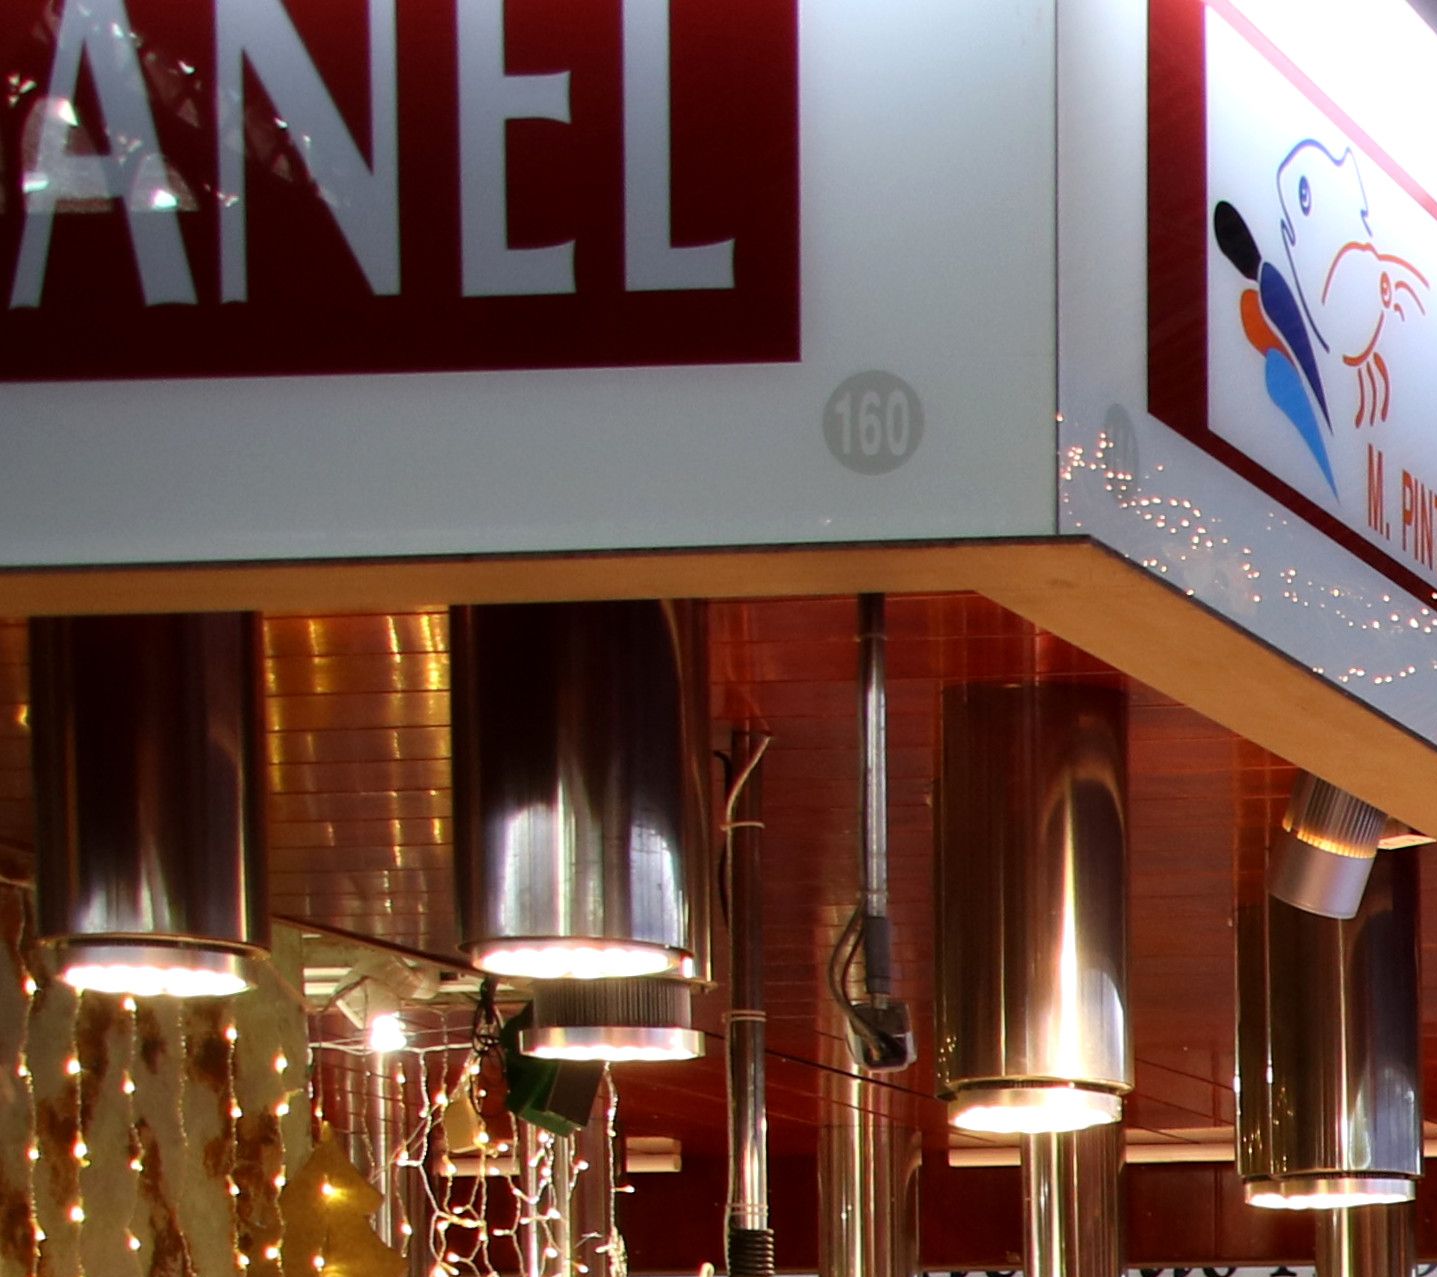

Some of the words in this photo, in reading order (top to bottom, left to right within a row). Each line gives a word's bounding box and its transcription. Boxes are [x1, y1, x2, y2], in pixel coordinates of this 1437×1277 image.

[8, 0, 736, 308] ANEL
[833, 388, 911, 459] 160
[1367, 443, 1391, 541] M.
